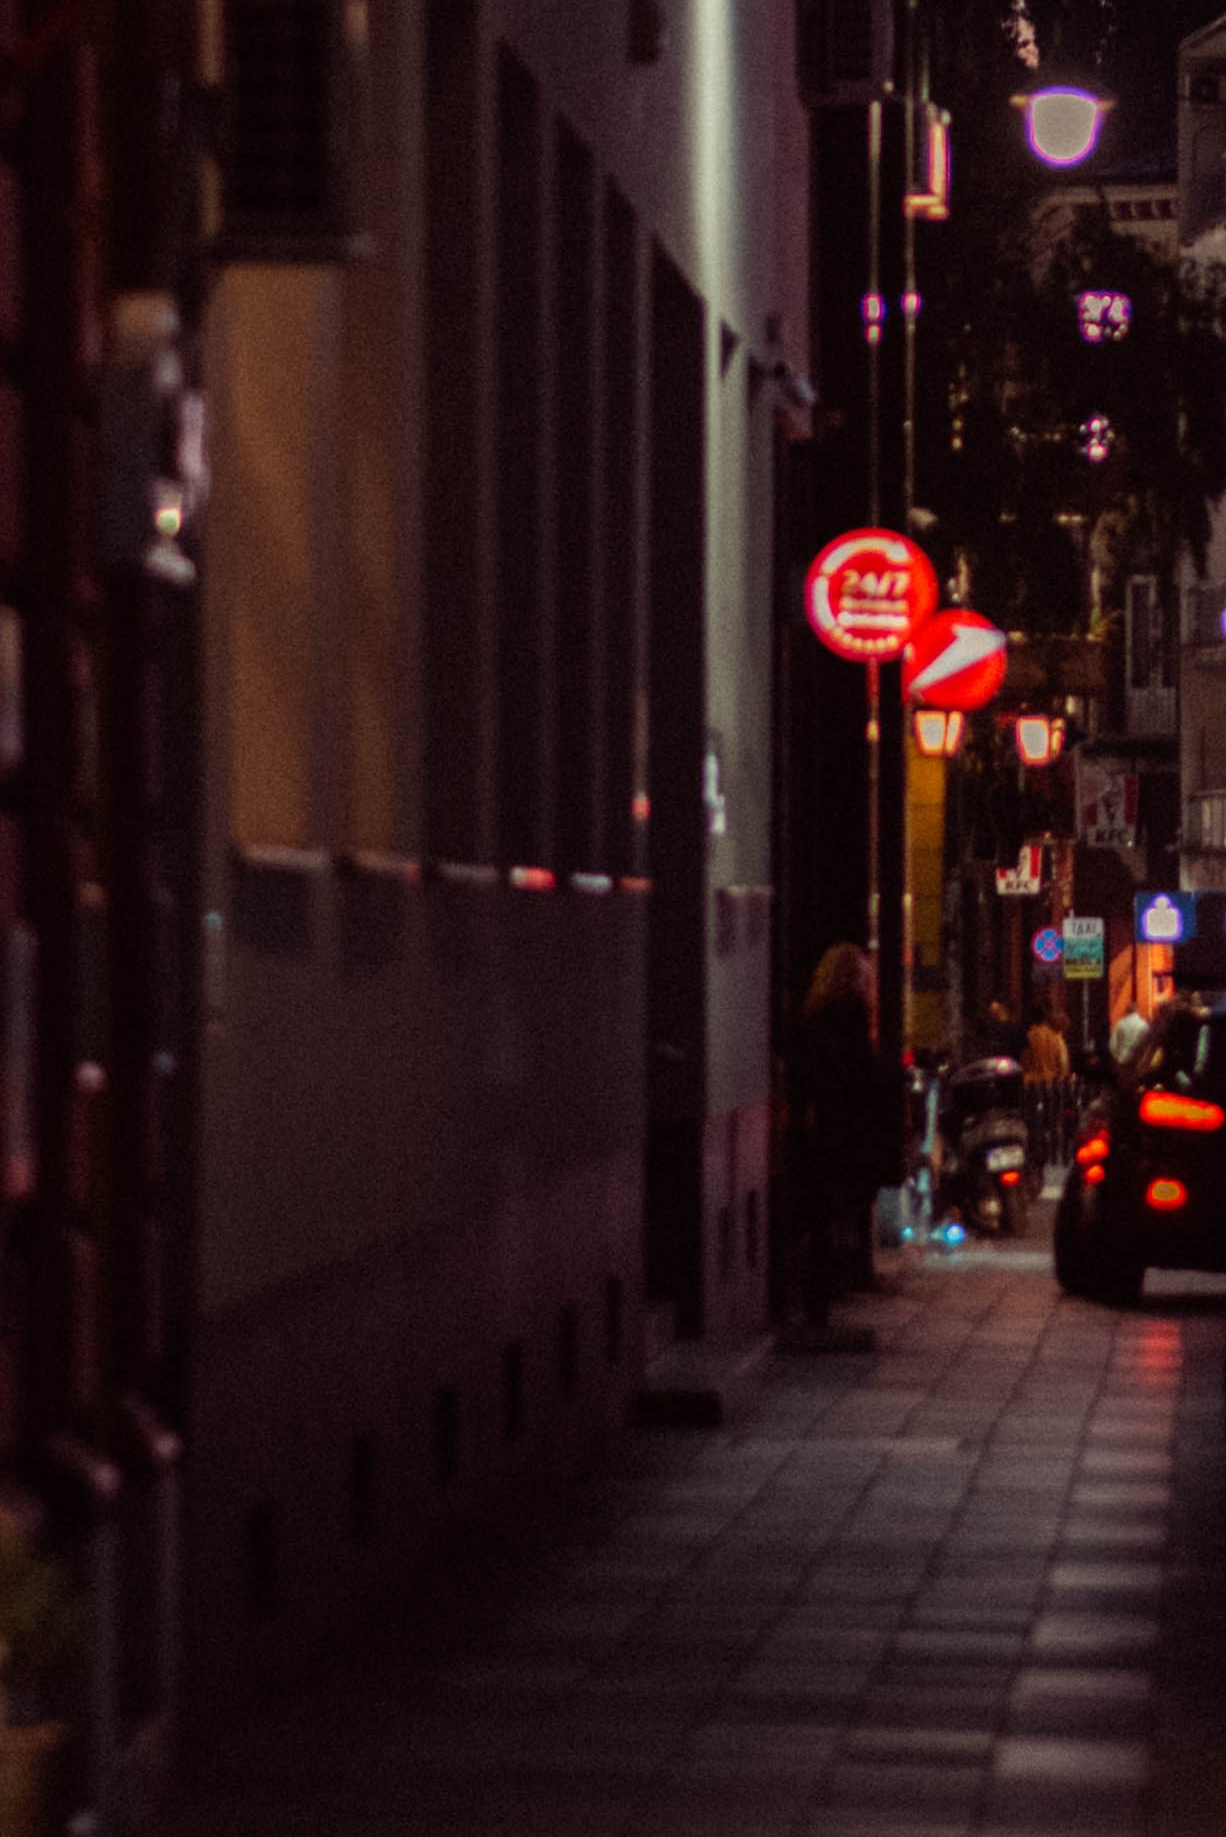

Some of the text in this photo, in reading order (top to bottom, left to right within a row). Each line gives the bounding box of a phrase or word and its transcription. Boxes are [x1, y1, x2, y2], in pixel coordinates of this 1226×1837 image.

[1094, 827, 1129, 845] KFC
[1005, 880, 1032, 892] KFC
[1071, 920, 1097, 937] TAXI
